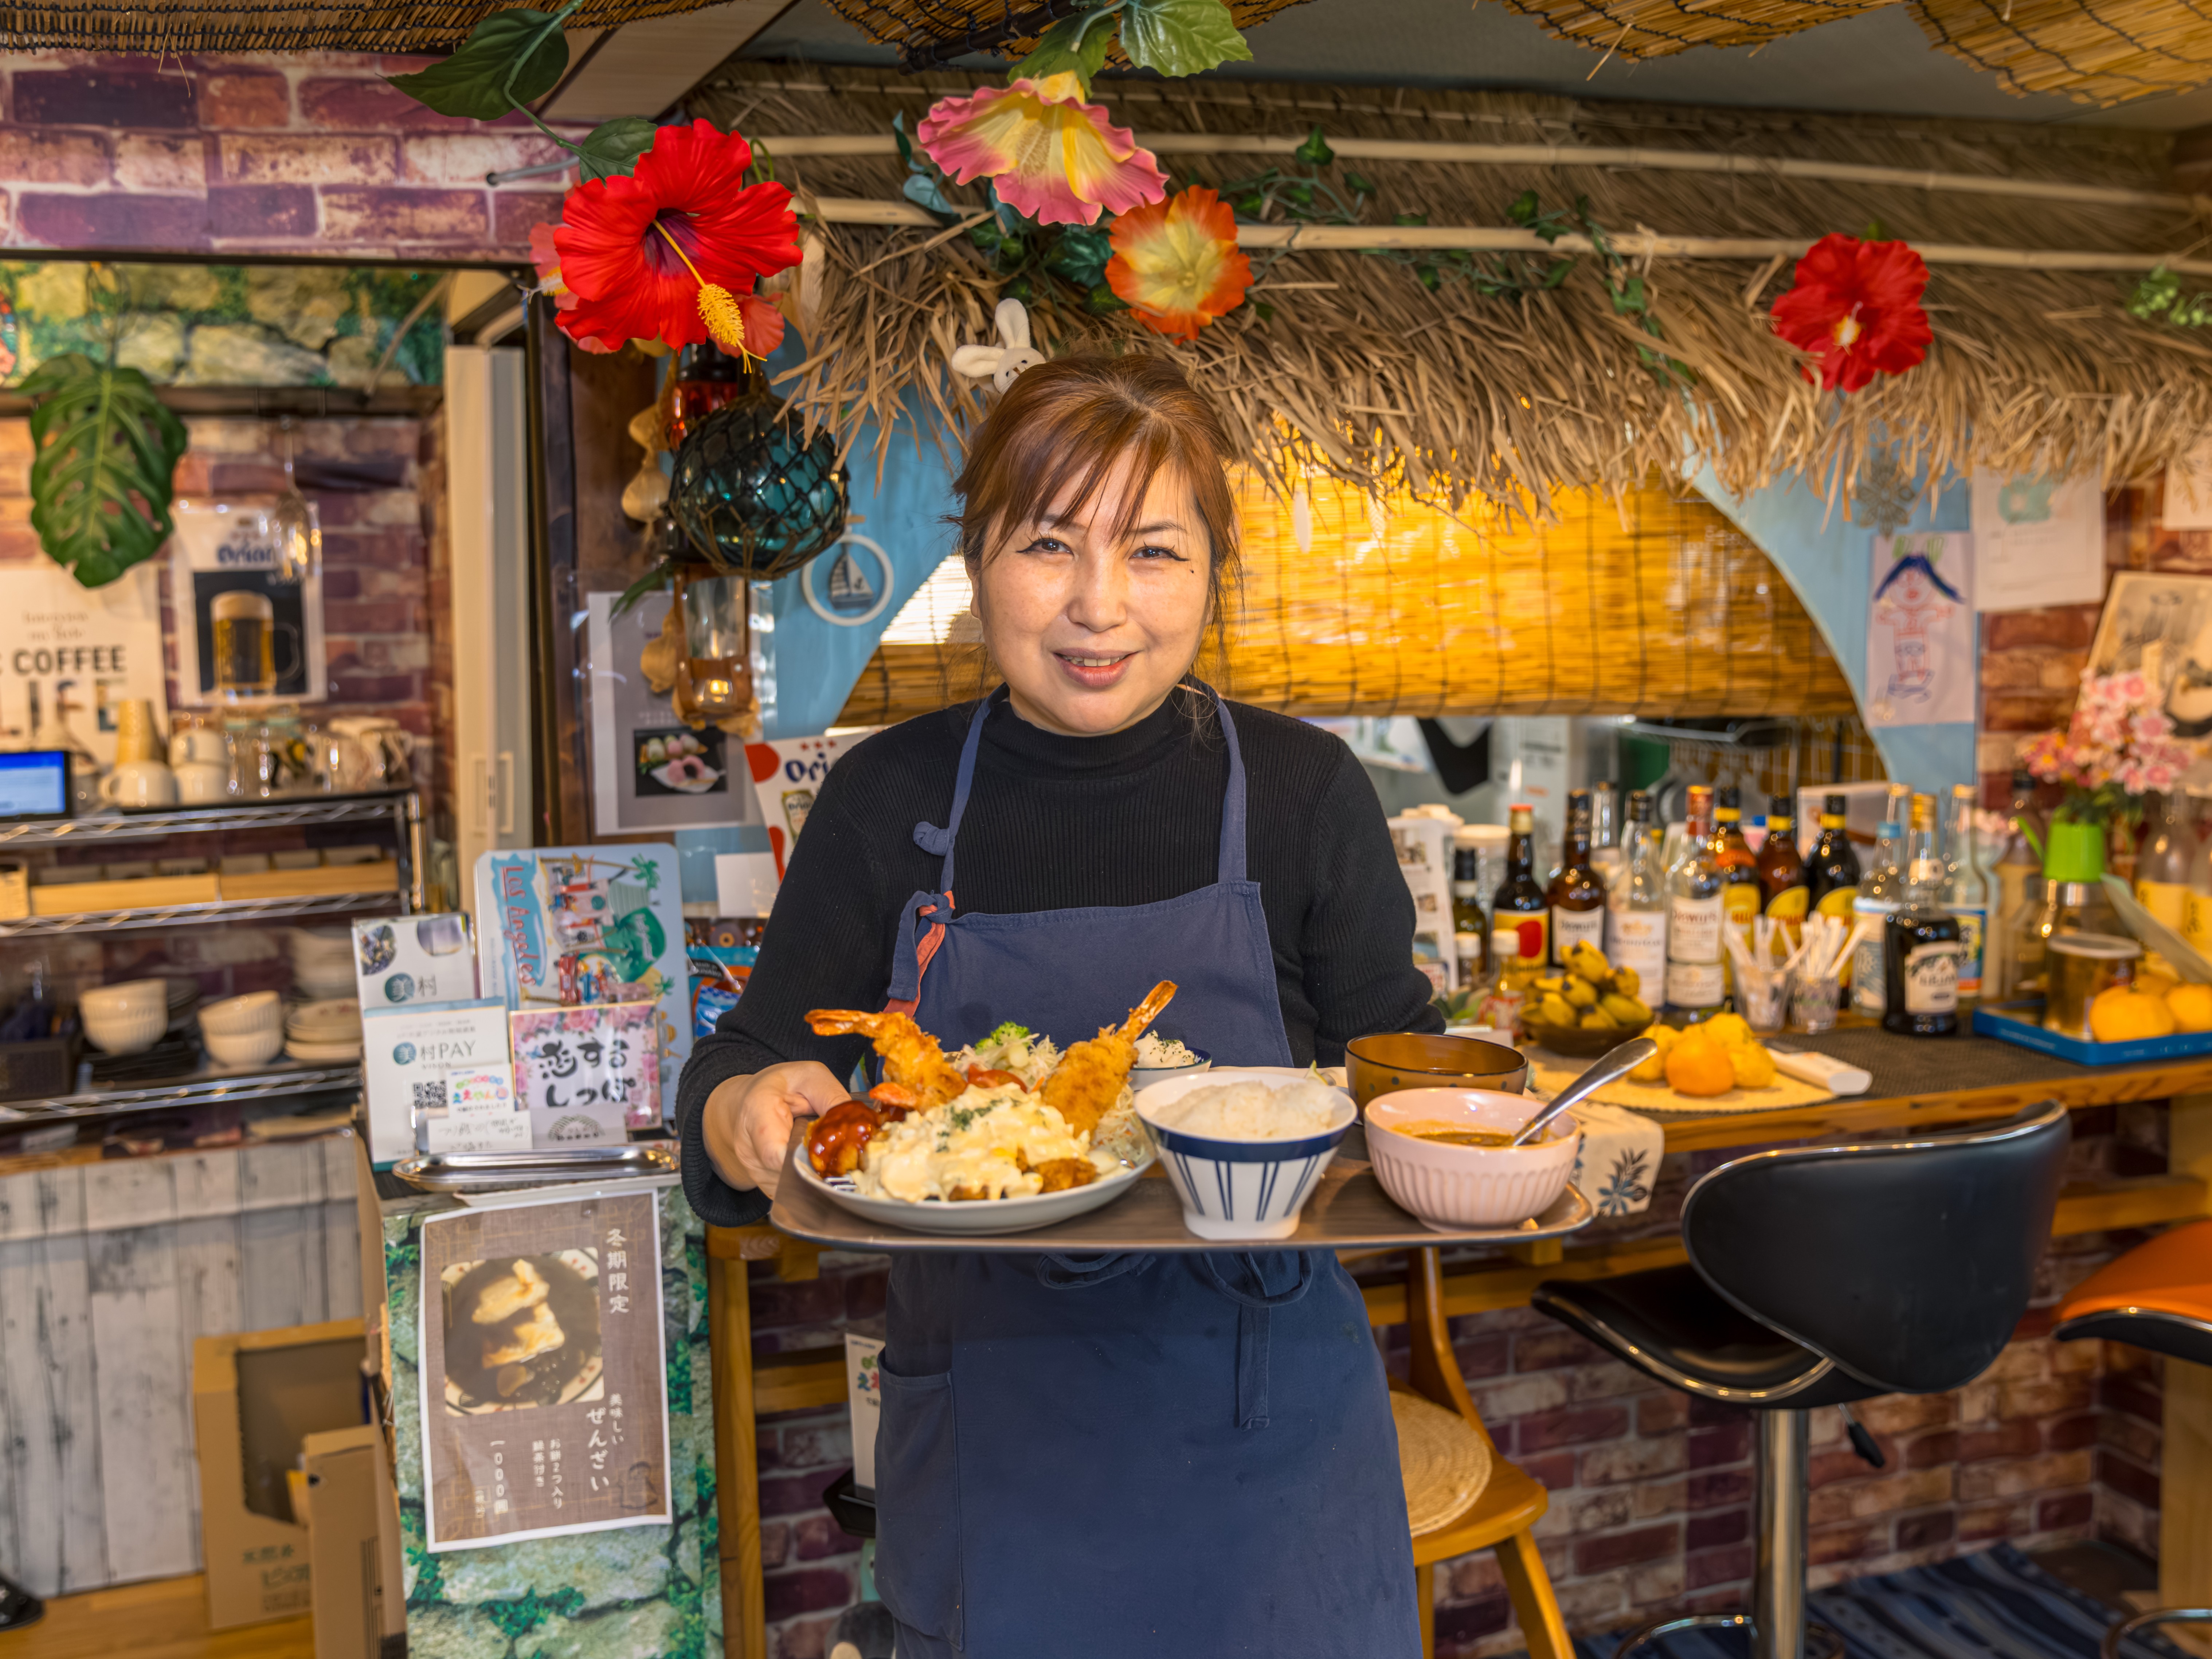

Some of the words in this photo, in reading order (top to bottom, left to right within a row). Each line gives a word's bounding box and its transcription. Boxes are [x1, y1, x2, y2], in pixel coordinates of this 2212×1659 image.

[12, 644, 127, 676] COFFEE
[504, 866, 525, 899] Los
[504, 905, 540, 986] Angeles
[537, 1037, 630, 1079] 恋する
[546, 1077, 637, 1107] しっぽ
[606, 1228, 630, 1314] 冬期限定
[609, 1393, 624, 1446] 美味しい
[586, 1406, 610, 1492] ぜんざい
